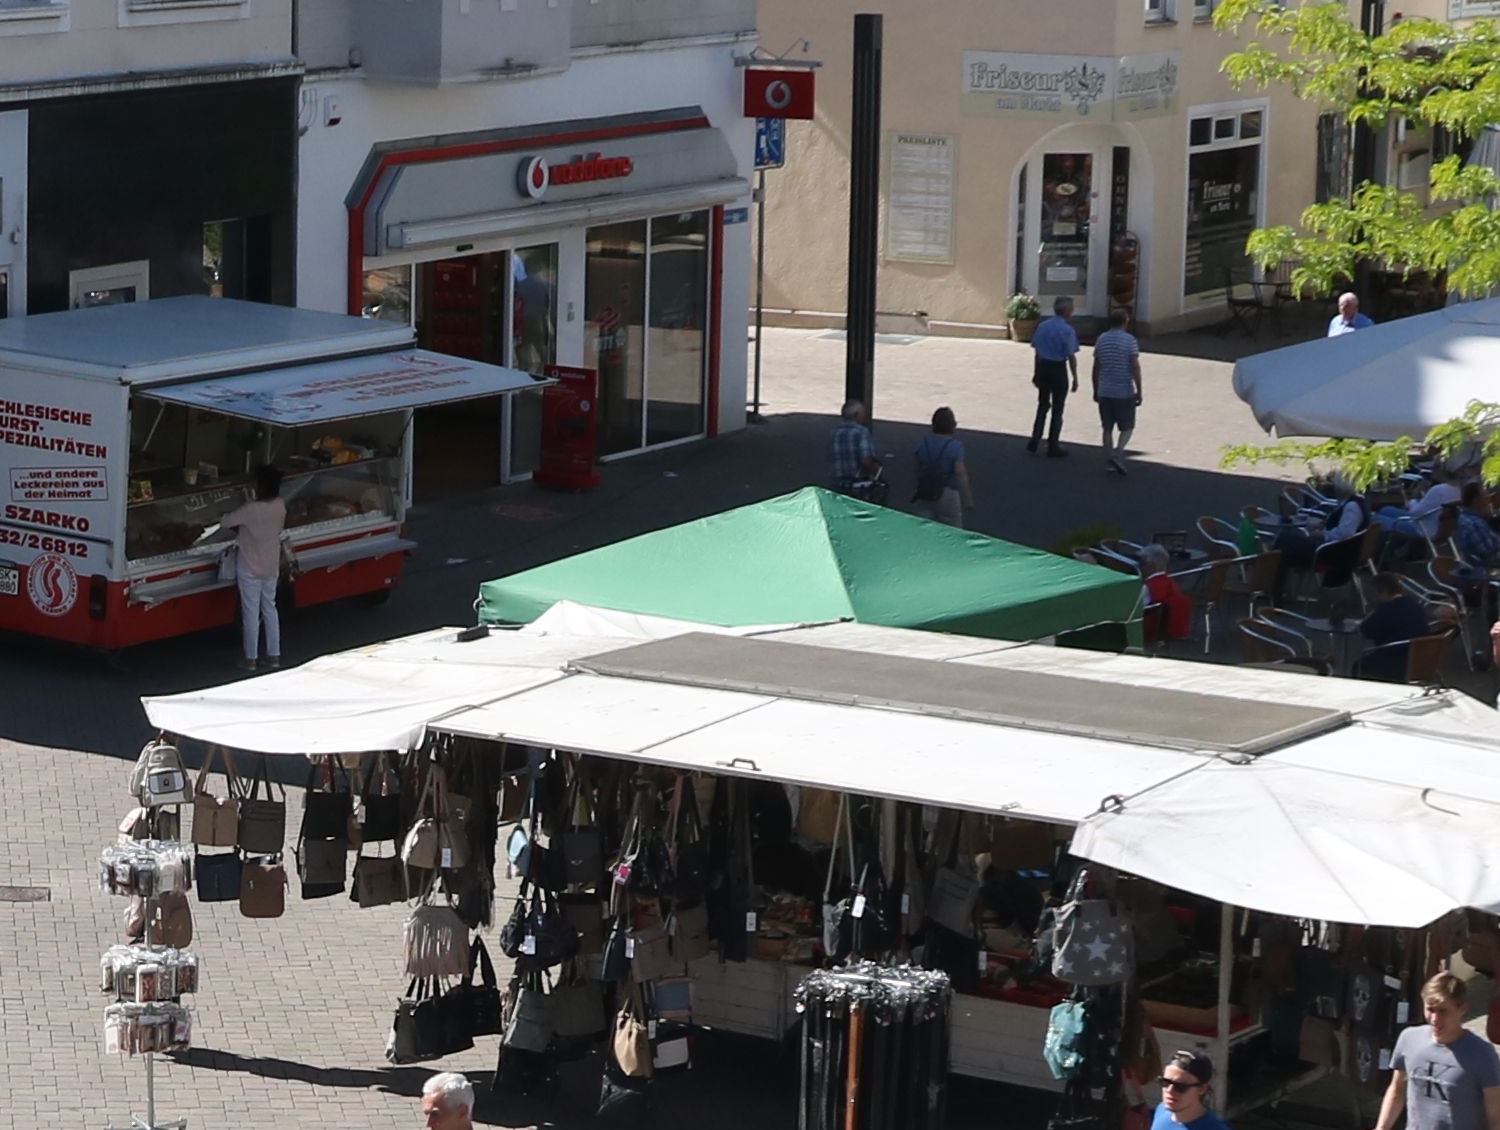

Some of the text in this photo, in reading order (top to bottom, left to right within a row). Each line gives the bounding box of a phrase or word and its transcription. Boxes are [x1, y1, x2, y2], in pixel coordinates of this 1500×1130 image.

[970, 62, 1060, 92] Friseur
[550, 152, 633, 186] vodafone
[55, 469, 98, 479] andere
[14, 480, 104, 490] Leckereien aus
[24, 489, 92, 499] der Heimat
[5, 505, 90, 533] SZARKO
